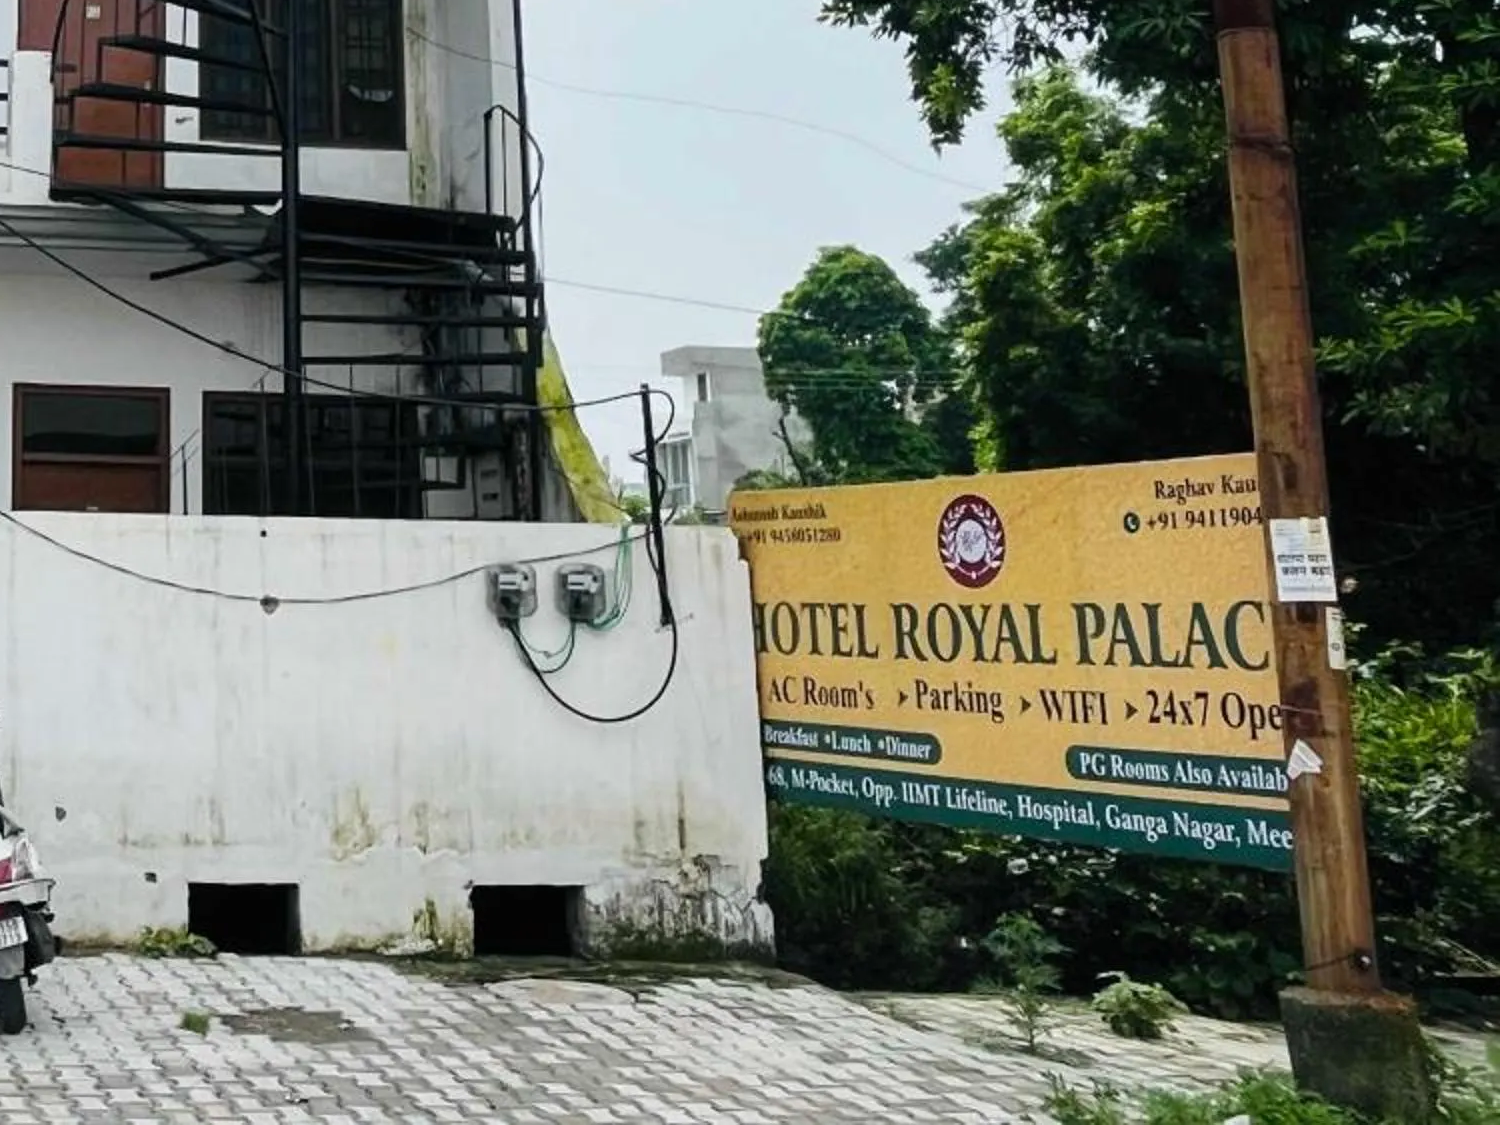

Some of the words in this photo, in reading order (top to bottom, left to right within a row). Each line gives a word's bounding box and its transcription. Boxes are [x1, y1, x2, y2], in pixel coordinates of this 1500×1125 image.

[1153, 477, 1216, 505] Raghav
[1220, 474, 1260, 494] Kau
[1146, 510, 1177, 531] +91
[1185, 506, 1264, 528] 9411904
[890, 601, 1057, 665] ROYAL
[1070, 599, 1270, 672] PALAC
[767, 676, 798, 705] AC
[803, 678, 875, 711] Room's
[914, 678, 1005, 725] Parking
[1039, 688, 1109, 726] WIFI
[1146, 688, 1210, 726] 24x7
[1220, 691, 1285, 742] Ope
[764, 724, 819, 748] Breakfast
[831, 730, 872, 754] Lunch
[885, 733, 932, 760] Dinner
[1078, 750, 1106, 776] PG
[1111, 754, 1170, 784] Rooms
[1173, 759, 1213, 787] Also
[1216, 763, 1289, 792] Availab
[791, 767, 860, 799] M-Pocket,
[861, 775, 901, 810] Opp.
[945, 784, 1014, 821] Lifeline,
[1016, 792, 1102, 830] Hospital,
[1104, 803, 1168, 842] Ganga
[1171, 810, 1242, 850] Nagar,
[1244, 817, 1294, 850] Mee
